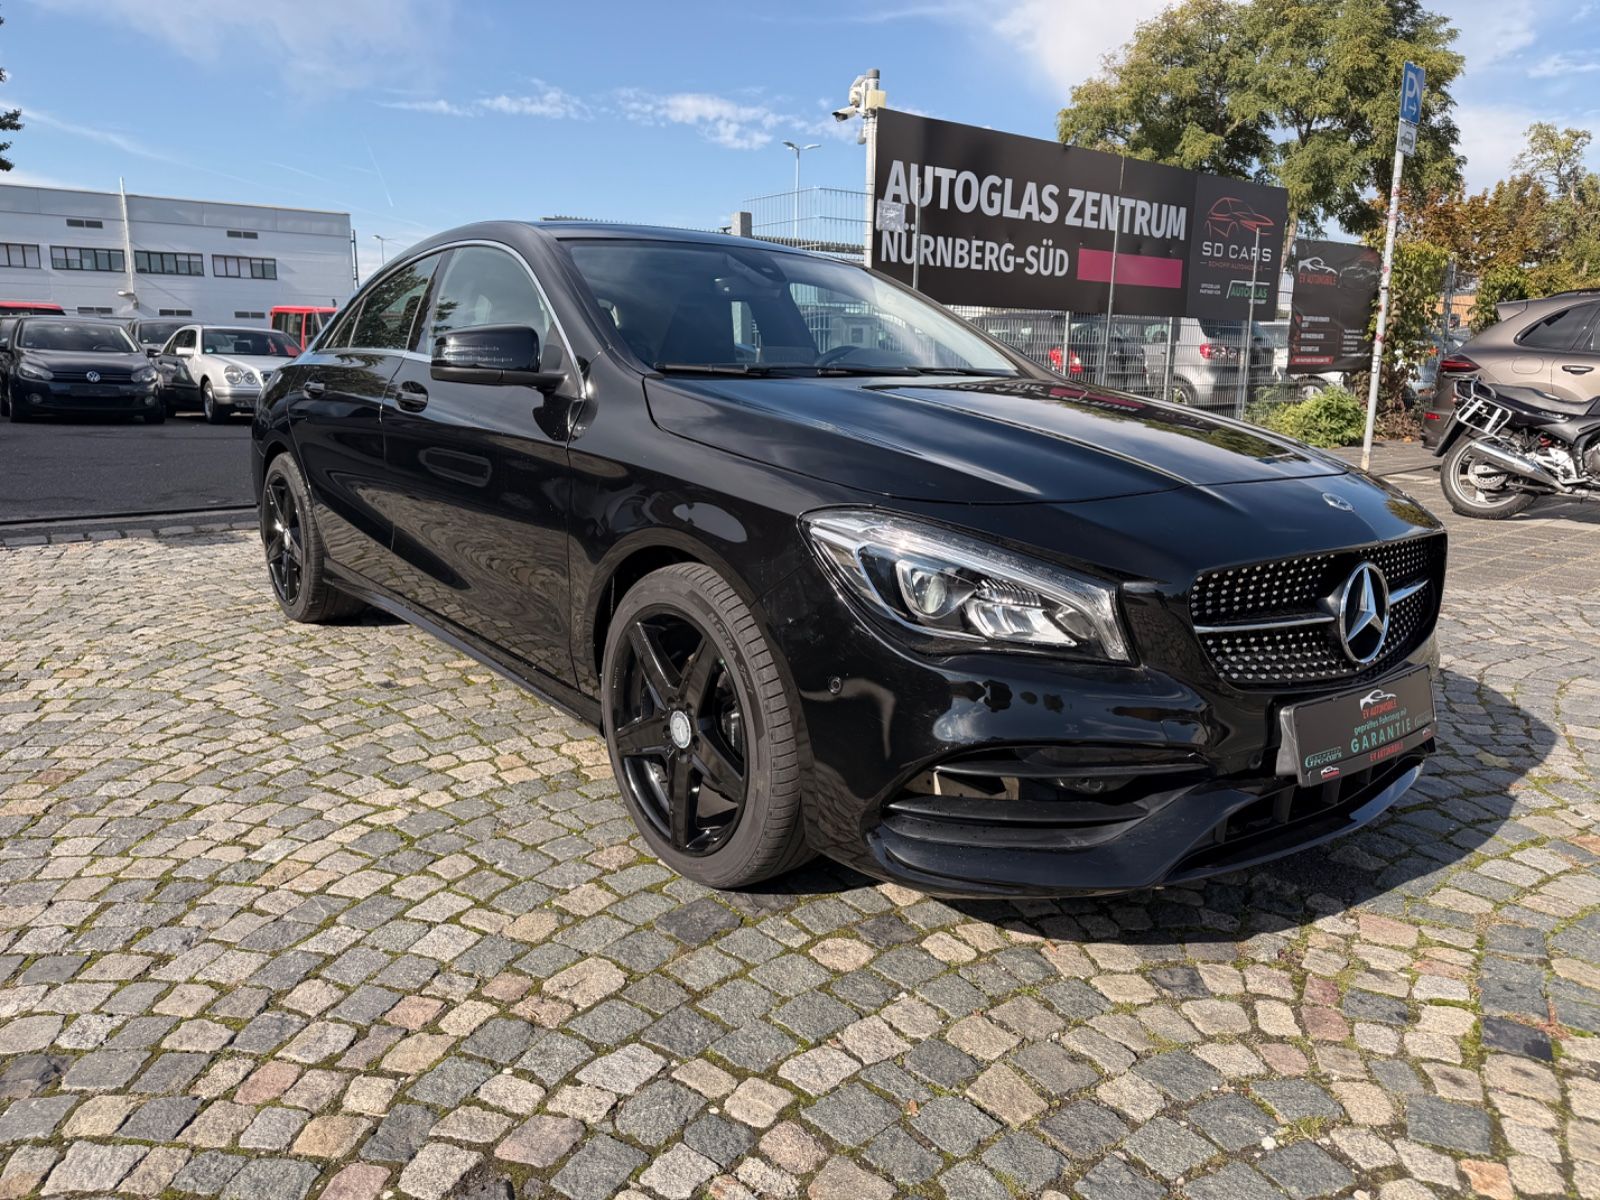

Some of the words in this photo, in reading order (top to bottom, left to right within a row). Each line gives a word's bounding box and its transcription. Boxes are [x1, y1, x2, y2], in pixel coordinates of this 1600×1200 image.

[1404, 70, 1417, 112] P
[883, 159, 1060, 224] AUTOGLAS
[1065, 187, 1187, 241] ZENTRUM
[881, 223, 1069, 277] NÜRNBERG-SÜD
[1202, 241, 1224, 257] SD
[1229, 244, 1272, 262] CARS
[1230, 286, 1268, 298] AUTOLAS
[1351, 718, 1411, 753] GARANTIE
